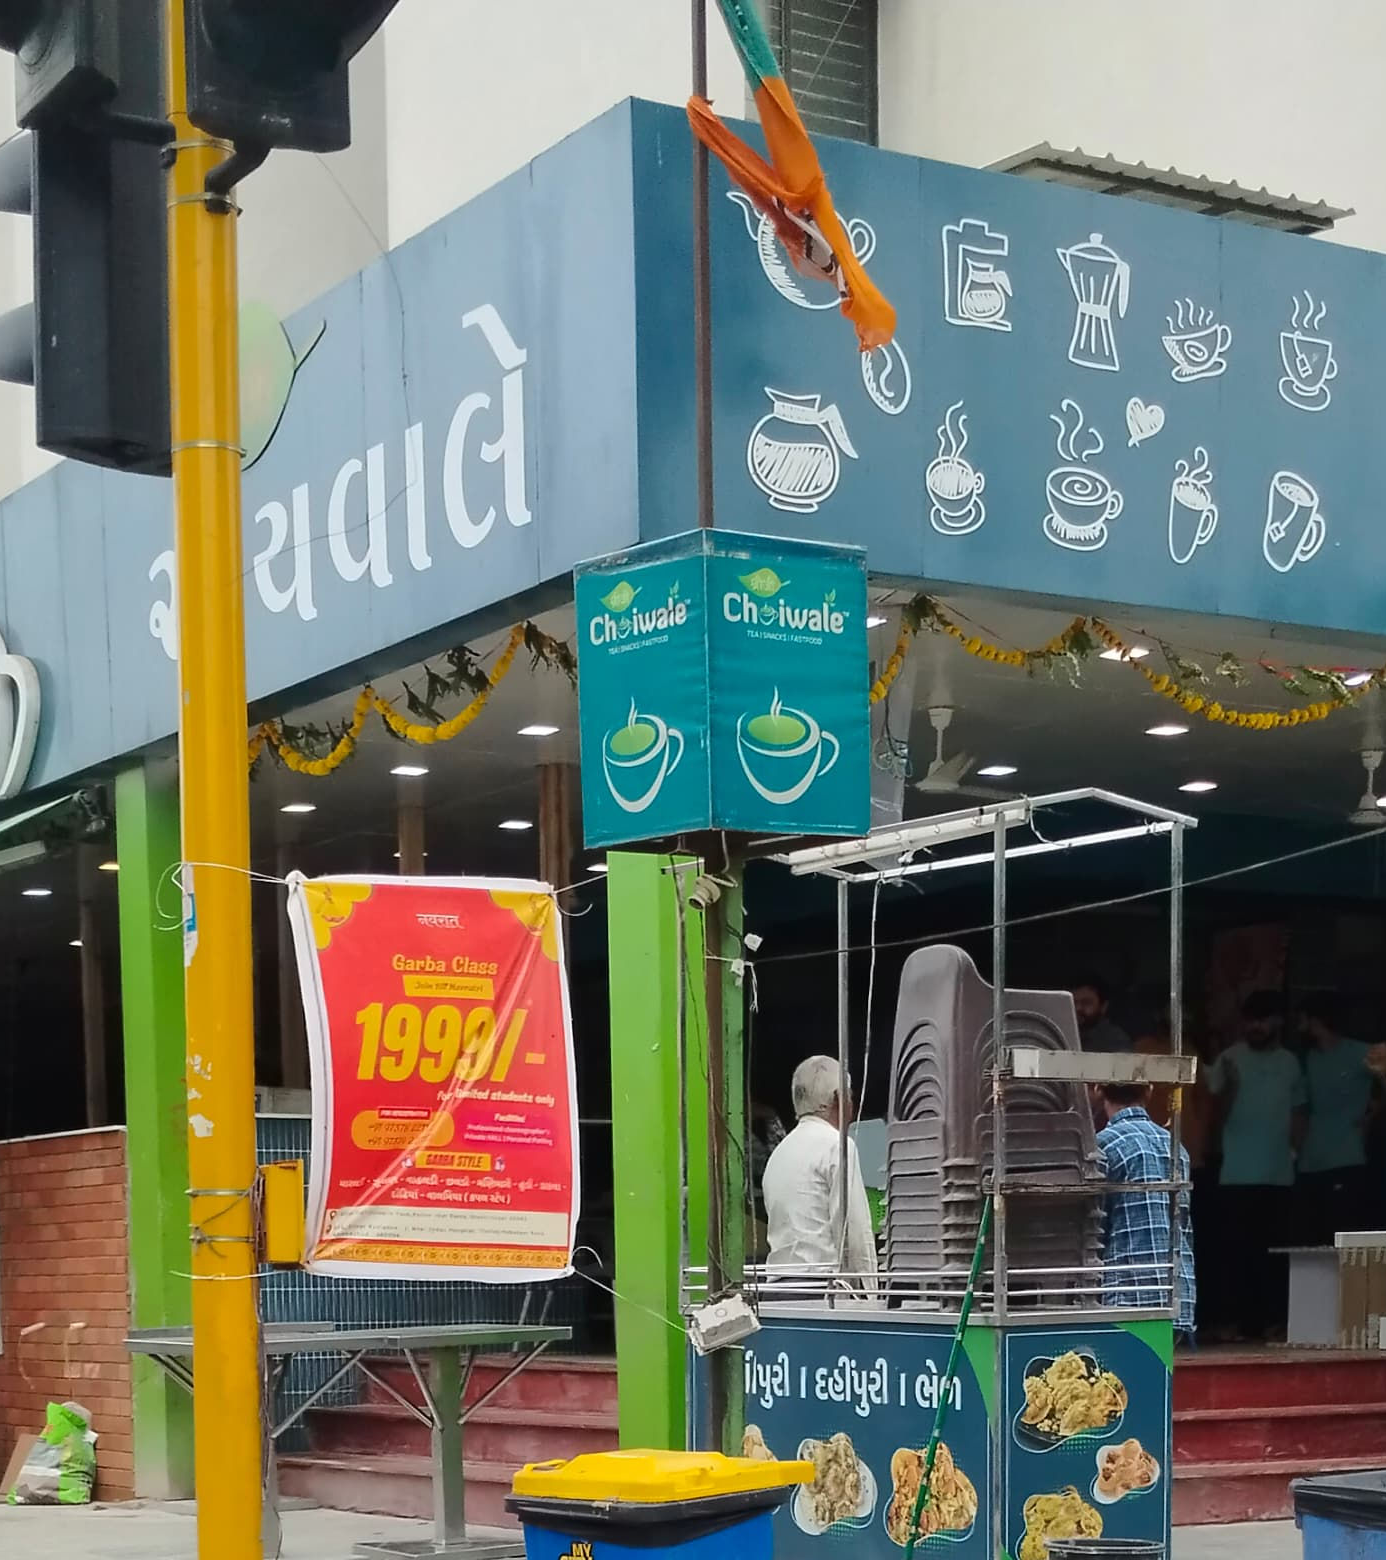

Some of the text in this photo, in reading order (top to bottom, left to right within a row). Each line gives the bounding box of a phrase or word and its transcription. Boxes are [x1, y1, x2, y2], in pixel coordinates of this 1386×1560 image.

[392, 953, 499, 975] Garba Class
[490, 1090, 534, 1103] students
[535, 1094, 555, 1108] only
[815, 1355, 889, 1418] દહીંપુરી
[572, 1543, 592, 1557] MY
